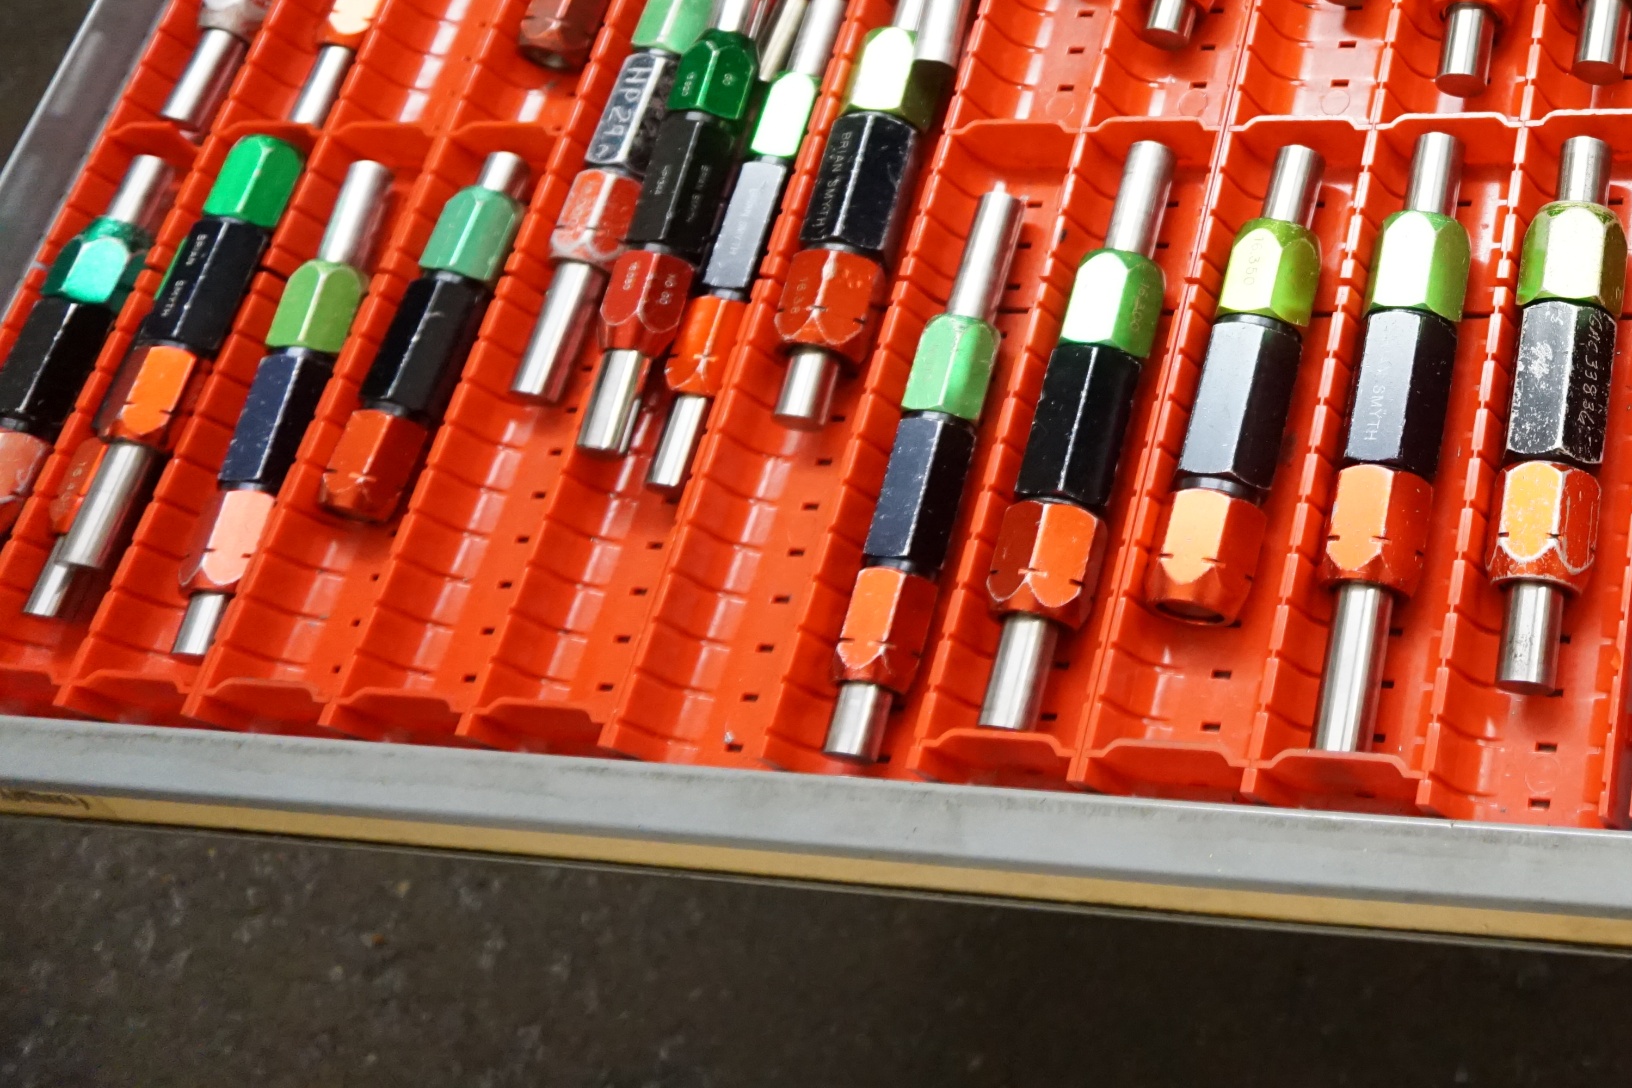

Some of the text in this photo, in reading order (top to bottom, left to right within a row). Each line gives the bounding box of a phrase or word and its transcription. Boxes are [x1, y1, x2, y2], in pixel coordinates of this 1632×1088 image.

[812, 131, 852, 228] BRIAN SMYTH
[1243, 237, 1265, 296] 16.350
[1364, 384, 1386, 441] SMYTH
